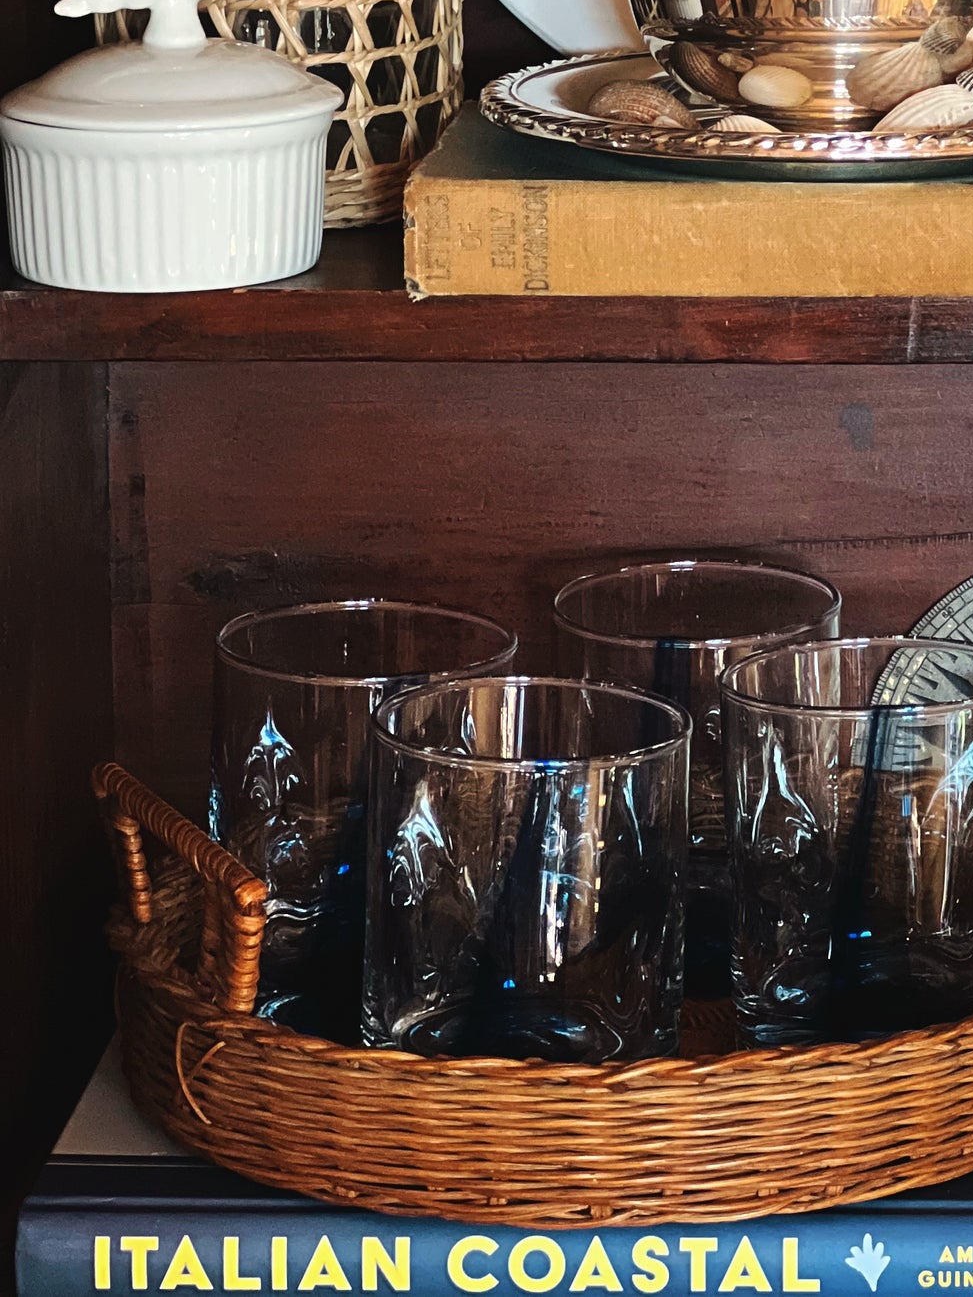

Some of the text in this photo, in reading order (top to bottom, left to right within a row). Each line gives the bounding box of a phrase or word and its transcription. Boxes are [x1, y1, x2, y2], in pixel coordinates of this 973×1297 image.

[424, 195, 451, 280] LETTERS
[459, 222, 482, 251] OF
[490, 207, 516, 269] EMILY
[522, 185, 549, 290] DICKINSON
[94, 1234, 821, 1293] ITALIAN COASTAL
